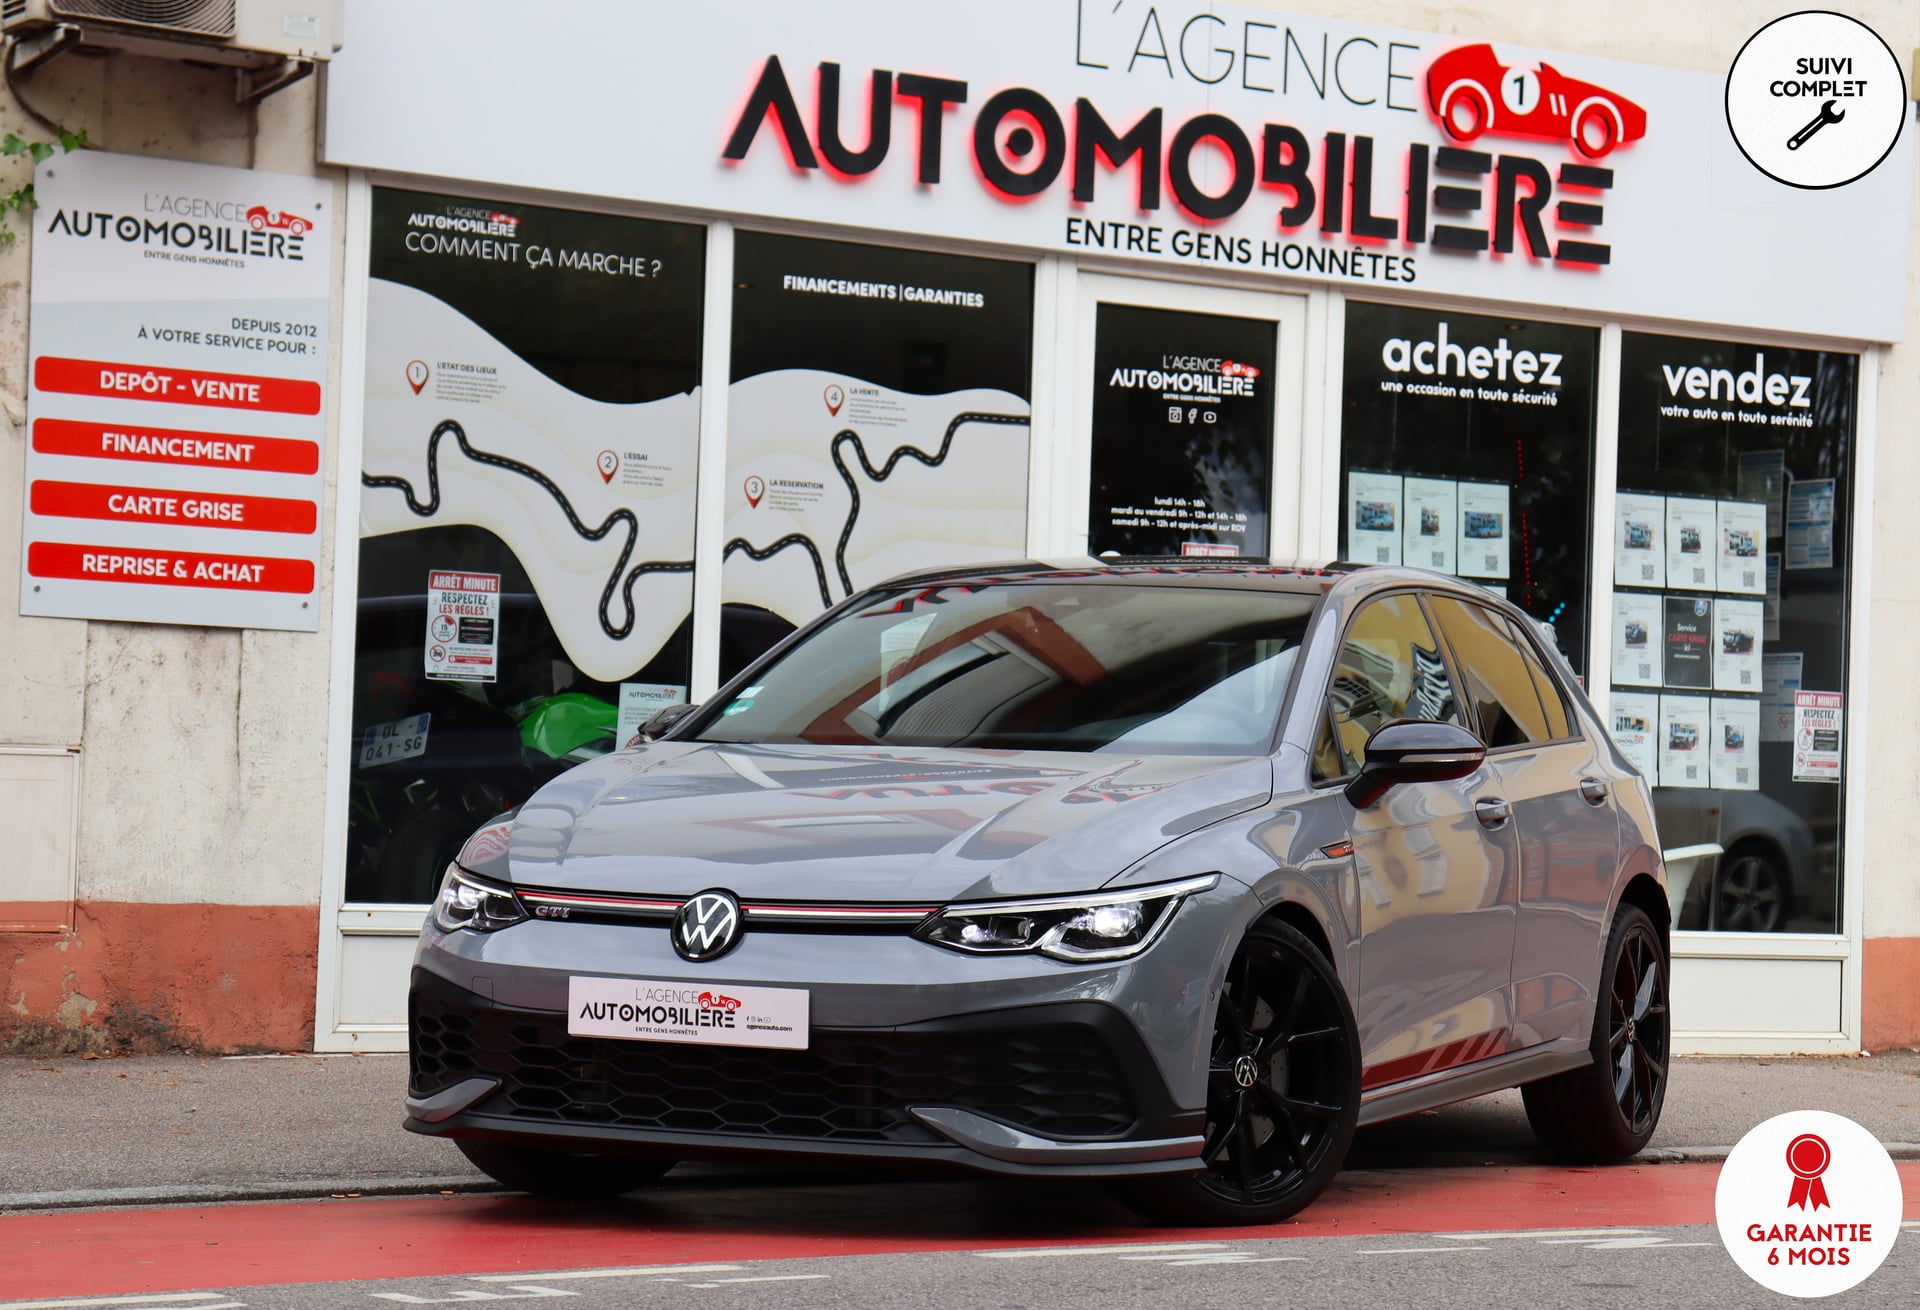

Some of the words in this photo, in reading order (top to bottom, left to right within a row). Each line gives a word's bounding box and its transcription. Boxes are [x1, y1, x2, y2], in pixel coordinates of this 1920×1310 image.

[1075, 0, 1420, 112] L'AGENCE
[1511, 75, 1529, 105] 1
[143, 192, 246, 222] L'AGENCE
[144, 250, 171, 262] ENTRE
[173, 253, 197, 264] GENS
[198, 255, 245, 269] HONNÊTES
[405, 232, 520, 263] COMMENT
[526, 245, 555, 269] ÇA
[558, 250, 645, 277] MARCHE
[652, 259, 662, 277] ?
[1067, 217, 1162, 254] ENTRE
[1172, 232, 1252, 263] GENS
[1262, 240, 1416, 284] HONNÊTES
[784, 275, 896, 299] FINANCEMENTS
[904, 286, 984, 308] GARANTIES
[231, 317, 281, 334] DEPUIS
[285, 322, 317, 337] 2012
[138, 324, 148, 339] À
[153, 327, 201, 345] VOTRE
[205, 332, 263, 350] SERVICE
[267, 337, 308, 354] POUR
[1382, 322, 1562, 386] achetez
[460, 364, 475, 372] DES
[476, 366, 497, 375] LIEUX
[1163, 355, 1221, 373] L'AGENCE
[100, 370, 172, 395] DEPÔT
[192, 378, 260, 403] VENTE
[1662, 352, 1812, 408] vendez
[830, 391, 838, 402] 4
[859, 388, 879, 396] VENTE
[1381, 381, 1403, 393] une
[1407, 382, 1456, 397] occasion
[1460, 387, 1474, 398] en
[1478, 387, 1509, 402] toute
[1512, 388, 1558, 406] sécurité
[1661, 405, 1689, 418] votre
[1693, 408, 1718, 420] auto
[1721, 411, 1735, 421] en
[1738, 409, 1767, 424] toute
[1770, 413, 1813, 428] serénité
[101, 432, 254, 463] FINANCEMENT
[604, 455, 612, 469] 2
[751, 481, 758, 493] 3
[108, 493, 177, 518] CARTE
[182, 498, 244, 522] GRISE
[1154, 496, 1173, 506] lundi
[1174, 498, 1187, 507] 14h
[1111, 506, 1133, 515] mardi
[1134, 508, 1144, 516] au
[1145, 508, 1177, 518] vendredi
[1178, 509, 1188, 518] 9h
[1195, 510, 1207, 519] 12h
[1208, 511, 1215, 519] et
[1216, 511, 1229, 520] 14h
[1112, 517, 1139, 527] samedi
[1140, 518, 1150, 527] 9h
[1156, 519, 1169, 528] 12h
[1170, 520, 1177, 529] et
[1231, 523, 1246, 533] RDV
[82, 552, 168, 577] REPRISE
[173, 558, 188, 579] &
[193, 559, 264, 584] ACHAT
[433, 574, 460, 588] ARRÊT
[464, 577, 496, 590] MINUTE
[441, 592, 488, 606] RESPECTEZ
[439, 604, 453, 615] LES
[1803, 708, 1835, 720] RESPECTEZ
[535, 905, 571, 918] GTI
[635, 987, 698, 1004] L'AGENCE
[669, 1028, 698, 1036] HONNÊTES
[746, 1024, 793, 1032] agenceauto.com
